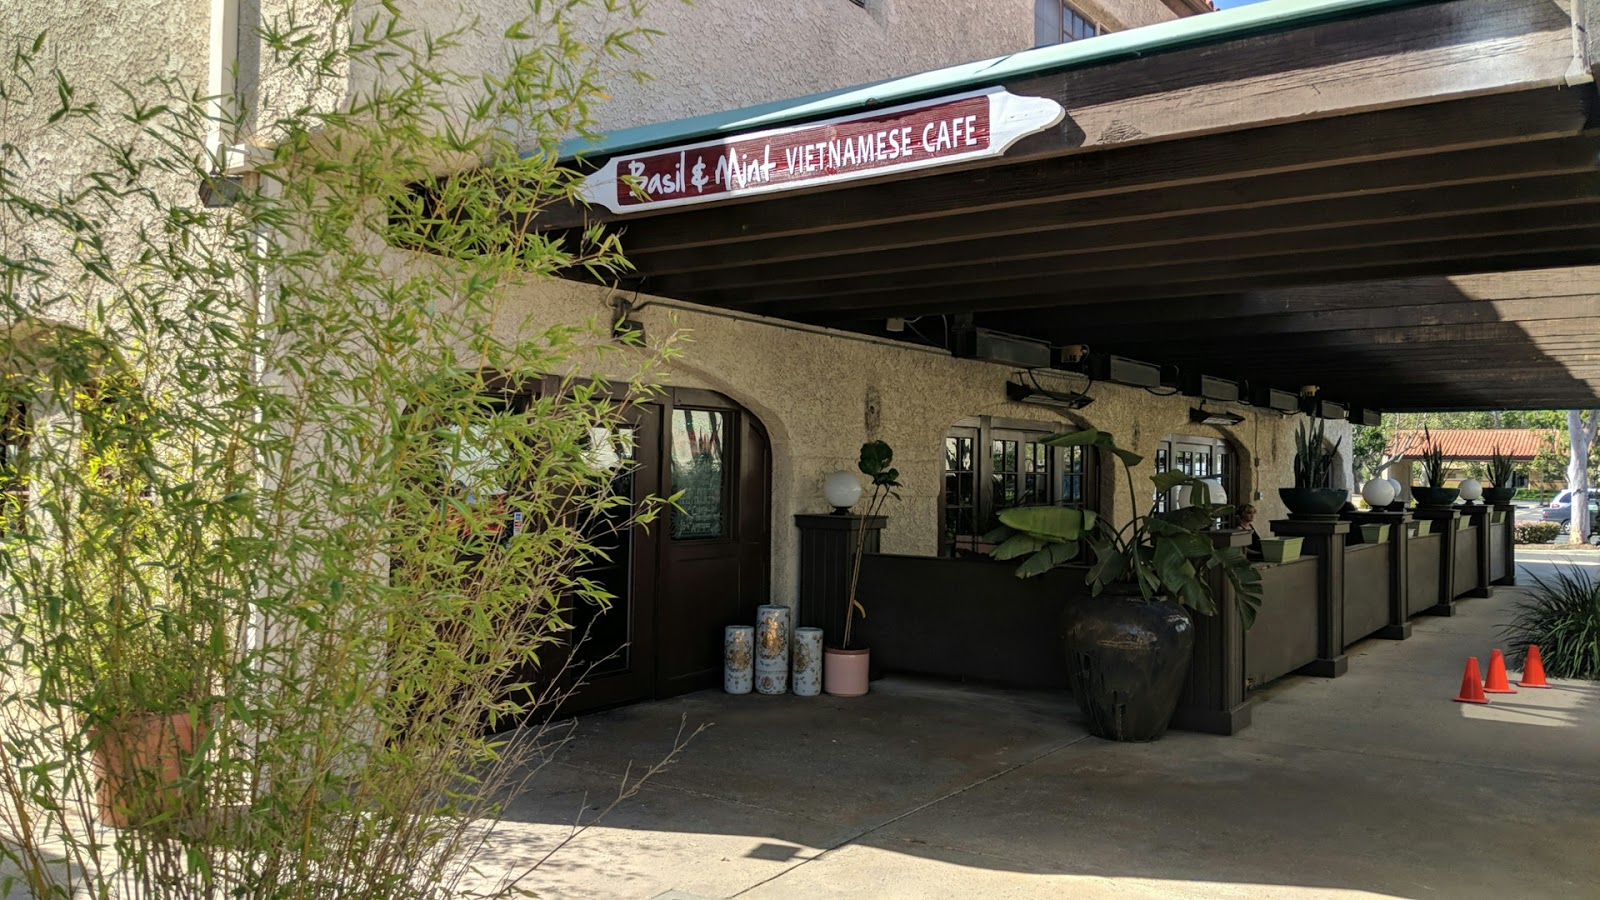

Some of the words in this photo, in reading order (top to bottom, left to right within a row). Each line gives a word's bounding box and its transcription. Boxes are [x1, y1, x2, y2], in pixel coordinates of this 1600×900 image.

[628, 150, 686, 197] Basil
[691, 156, 709, 193] &
[715, 144, 777, 191] Mint
[785, 127, 913, 175] VIETNAMESE
[922, 115, 977, 153] CAFE
